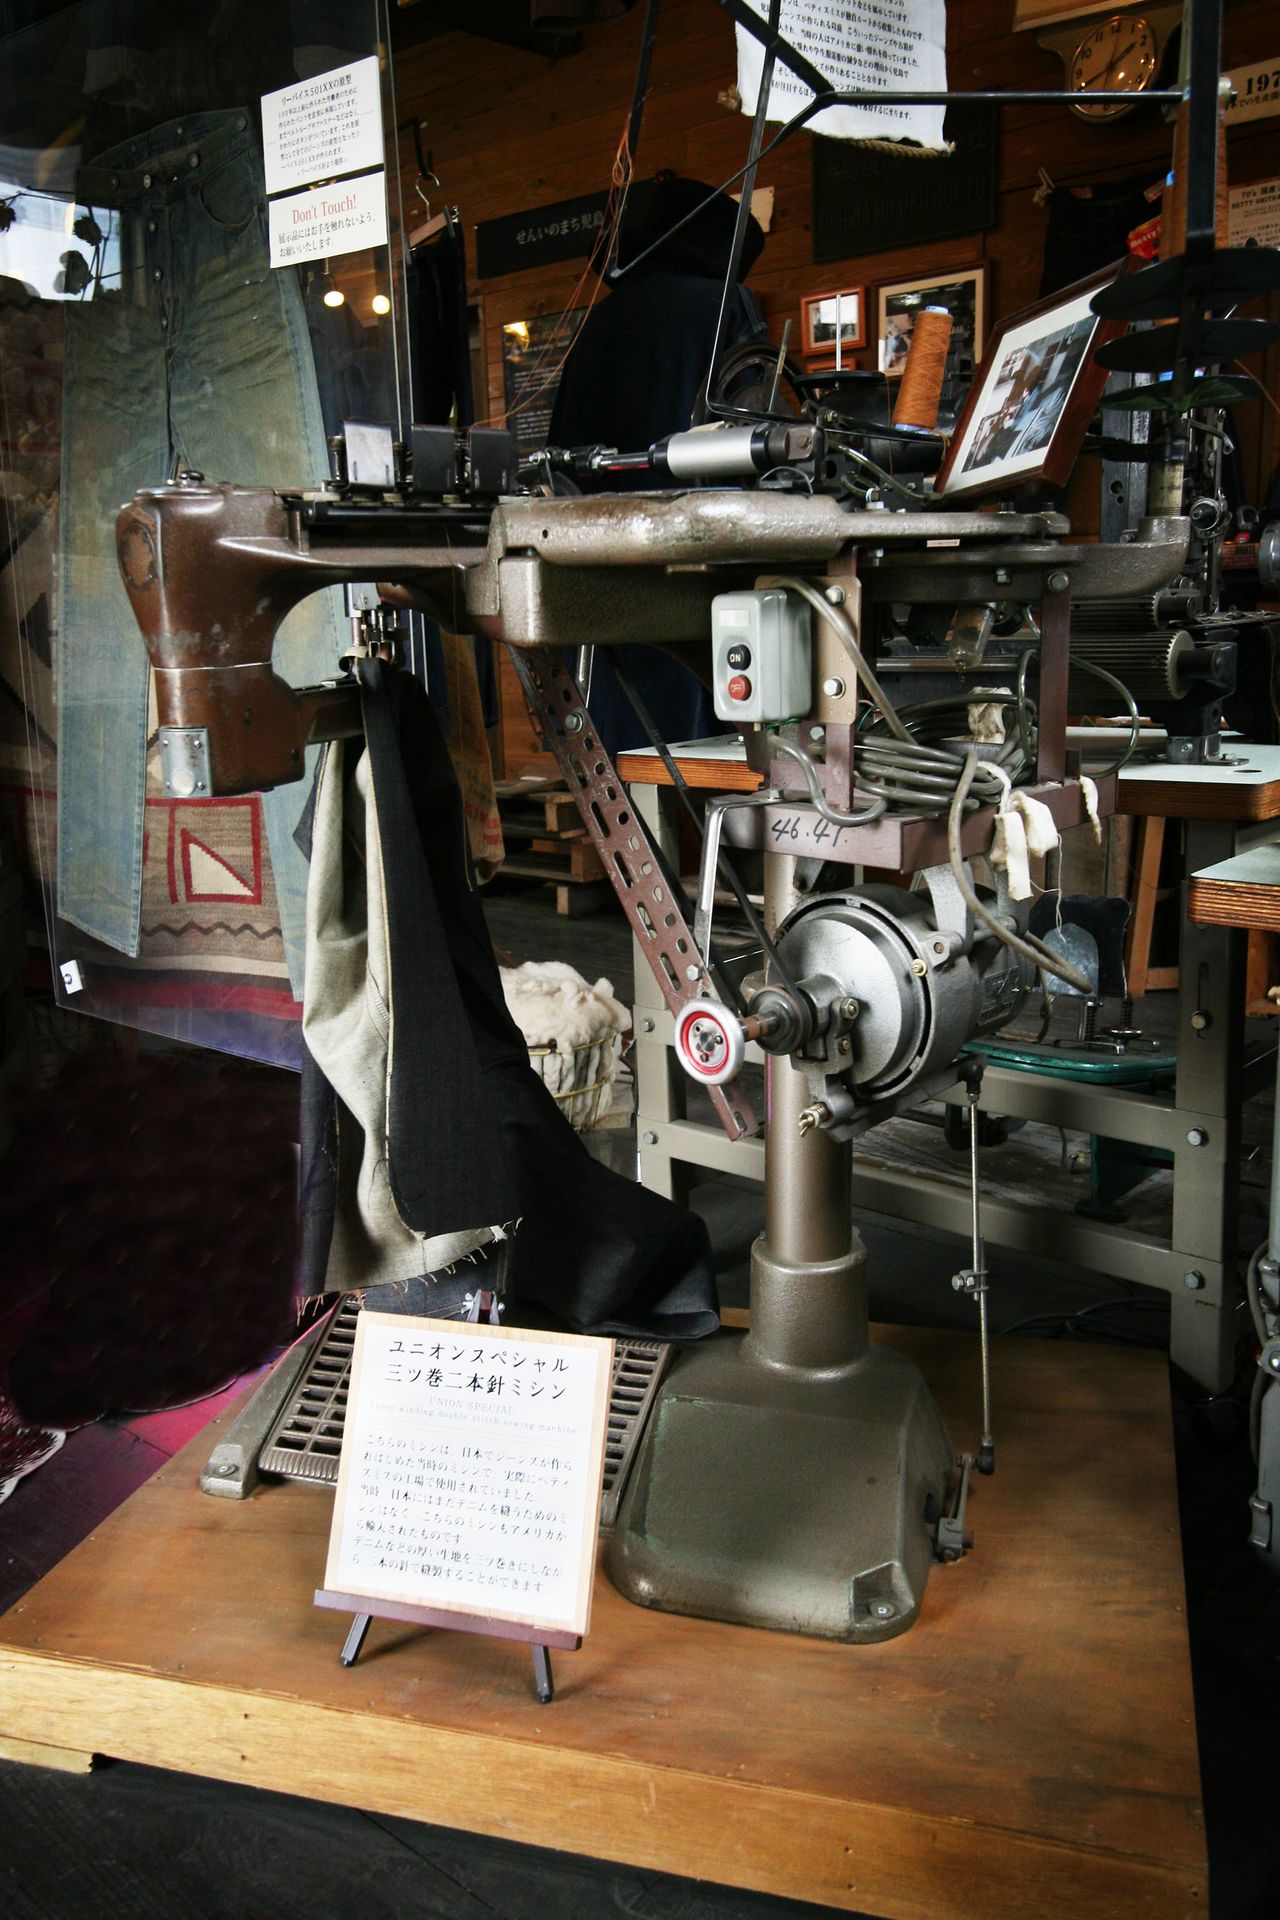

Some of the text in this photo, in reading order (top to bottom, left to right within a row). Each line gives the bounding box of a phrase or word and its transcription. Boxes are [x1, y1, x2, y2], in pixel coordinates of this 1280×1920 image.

[1111, 21, 1121, 34] 12
[1095, 31, 1104, 43] 11
[1140, 35, 1147, 46] 2
[292, 194, 357, 225] Don't Touch!
[729, 654, 741, 663] ON
[730, 684, 742, 692] OFF
[389, 1340, 570, 1373] ユニオンスペシャル
[385, 1363, 567, 1400] 三ツ巻二本針ミシン
[429, 1396, 513, 1416] UNION SPECIAL
[399, 1405, 434, 1418] winding
[437, 1409, 467, 1421] double
[471, 1414, 499, 1426] stitch
[538, 1423, 577, 1435] machine
